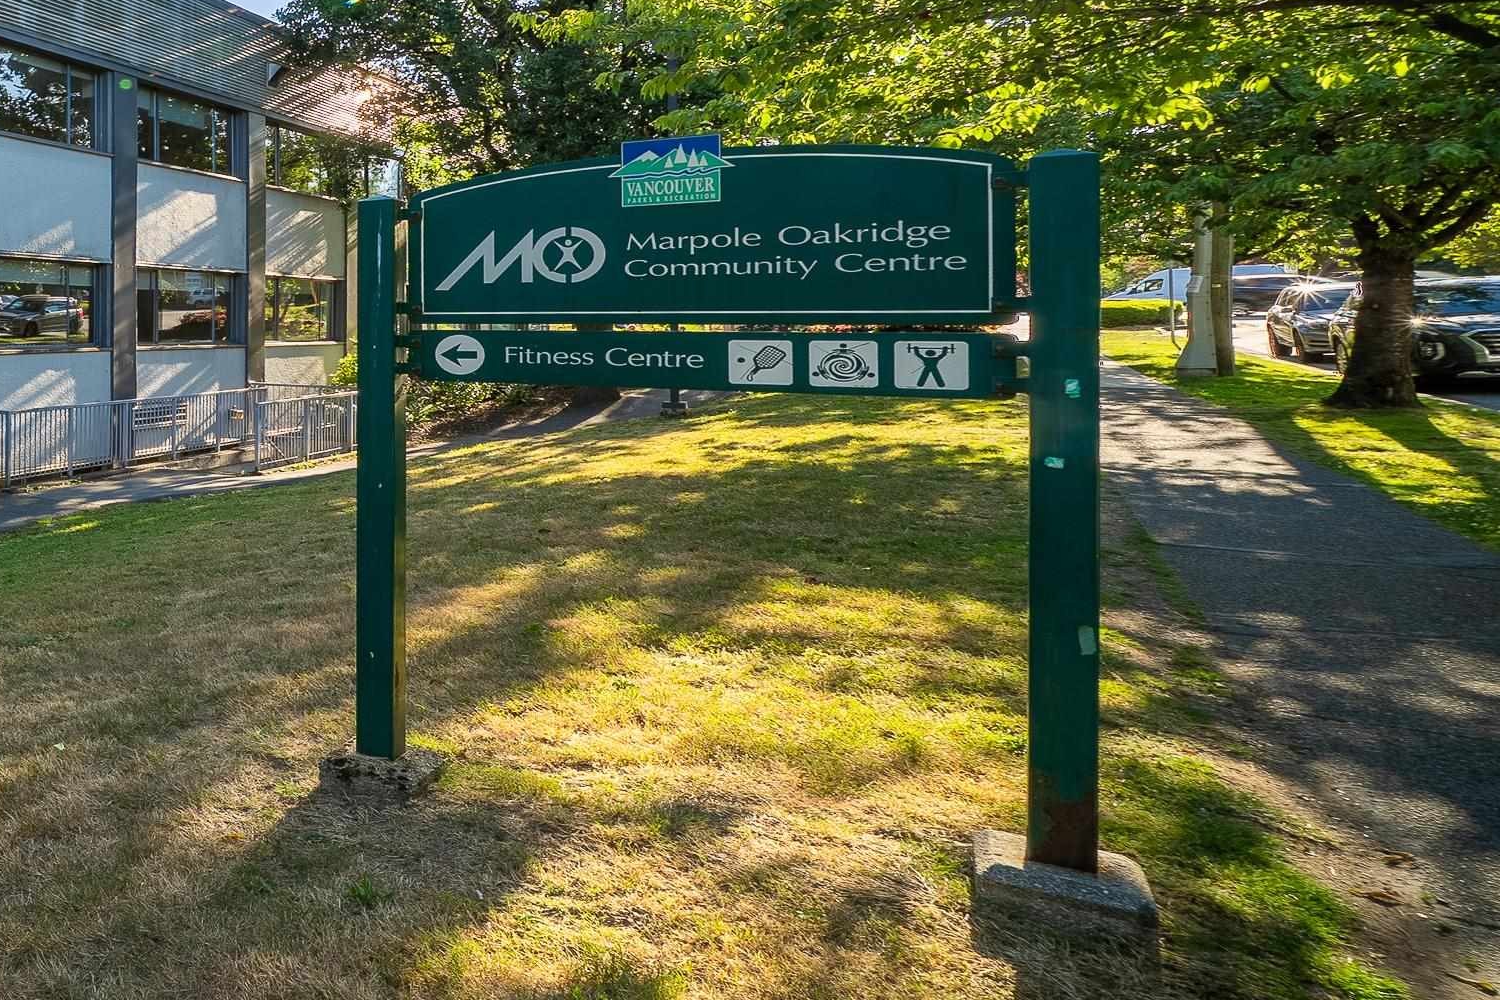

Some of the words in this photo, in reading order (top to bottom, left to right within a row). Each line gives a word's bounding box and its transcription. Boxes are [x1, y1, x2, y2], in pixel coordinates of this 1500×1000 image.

[627, 177, 715, 196] VANCOUVER
[627, 196, 653, 204] PARKS
[664, 193, 716, 202] RECREATION
[626, 226, 762, 255] Marpole
[778, 220, 951, 248] Oakridge
[624, 255, 818, 280] Community
[835, 253, 968, 273] Centre
[504, 346, 595, 365] Fitness
[605, 347, 705, 369] Centre
